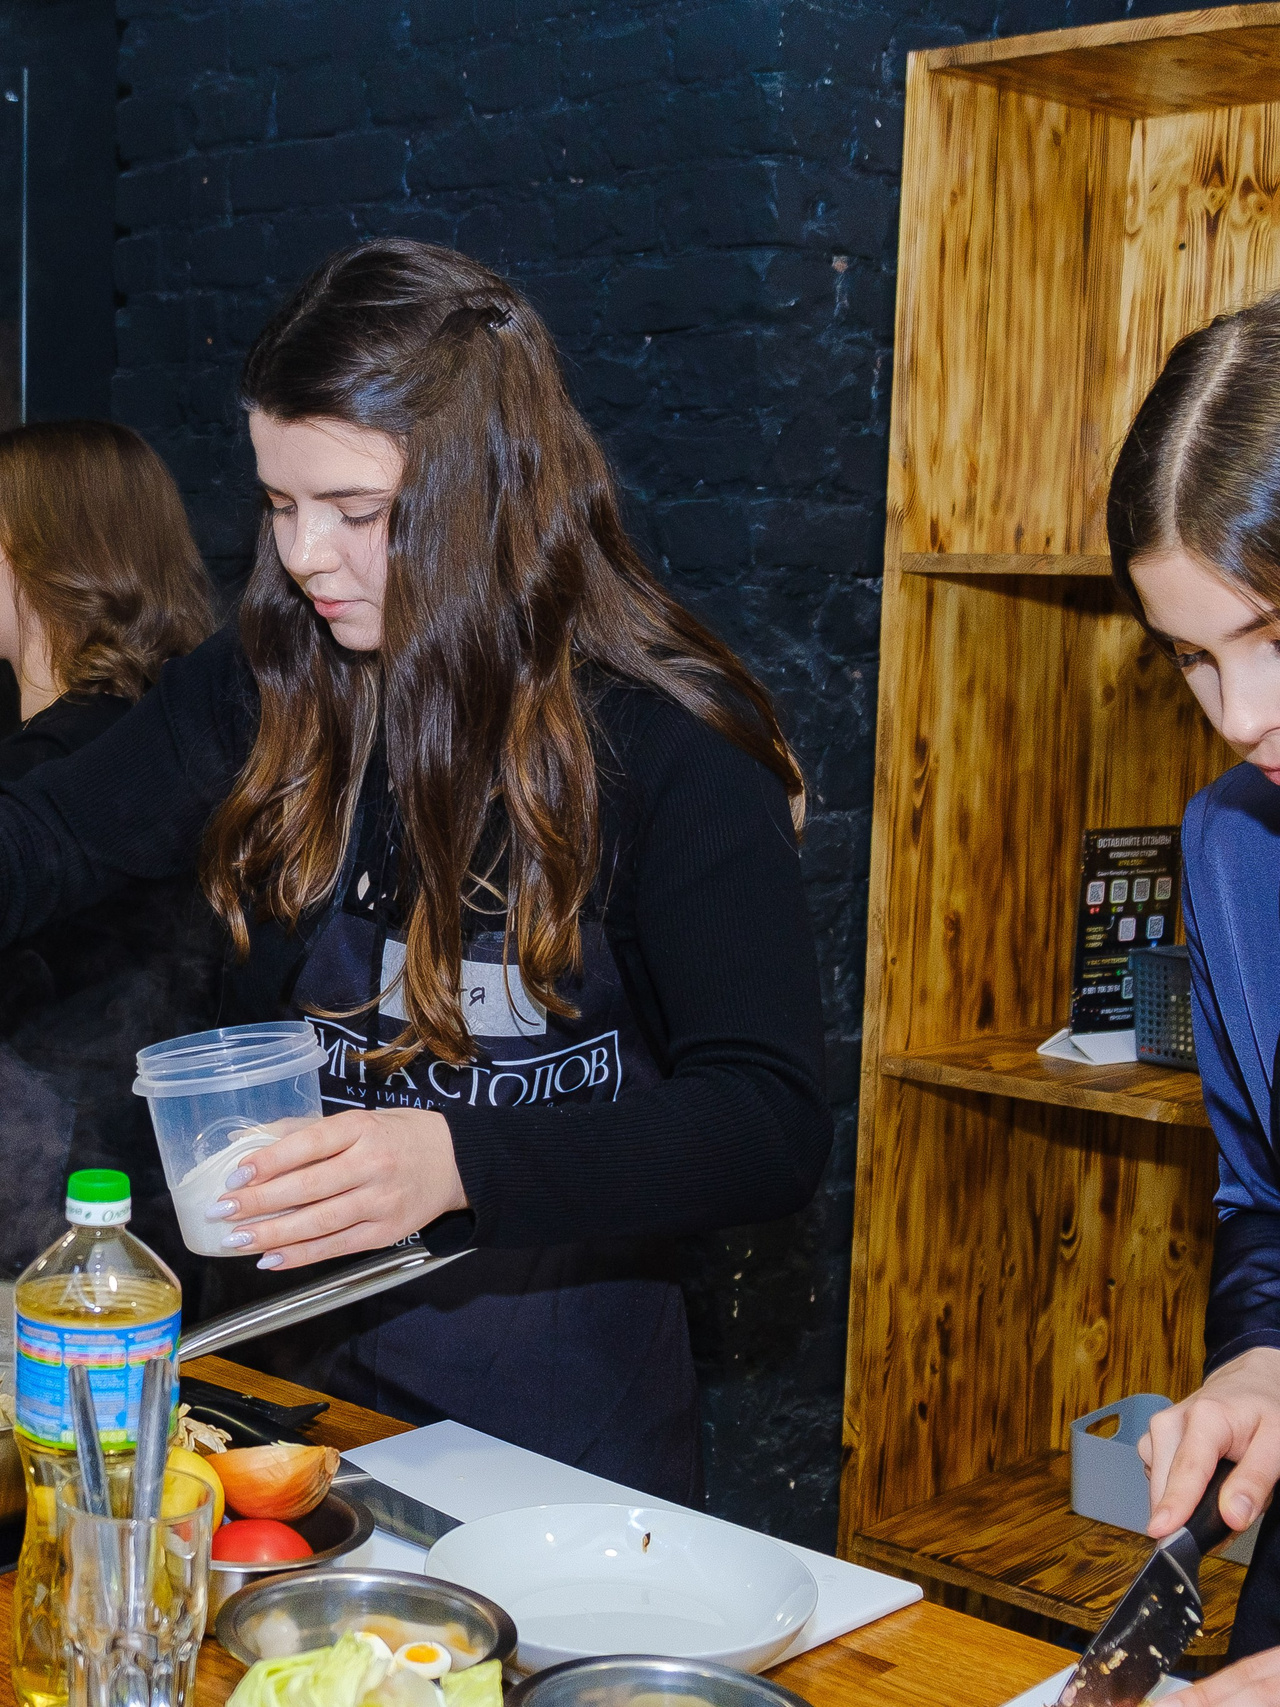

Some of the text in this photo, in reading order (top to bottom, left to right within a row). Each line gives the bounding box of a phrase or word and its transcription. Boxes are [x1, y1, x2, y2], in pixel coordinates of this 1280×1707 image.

[1097, 834, 1172, 849] ОСТАВЛЯЙТЕ ОТЗЫВЫ
[427, 1046, 610, 1106] СТОЛОВ
[346, 1085, 446, 1110] КУИНАР
